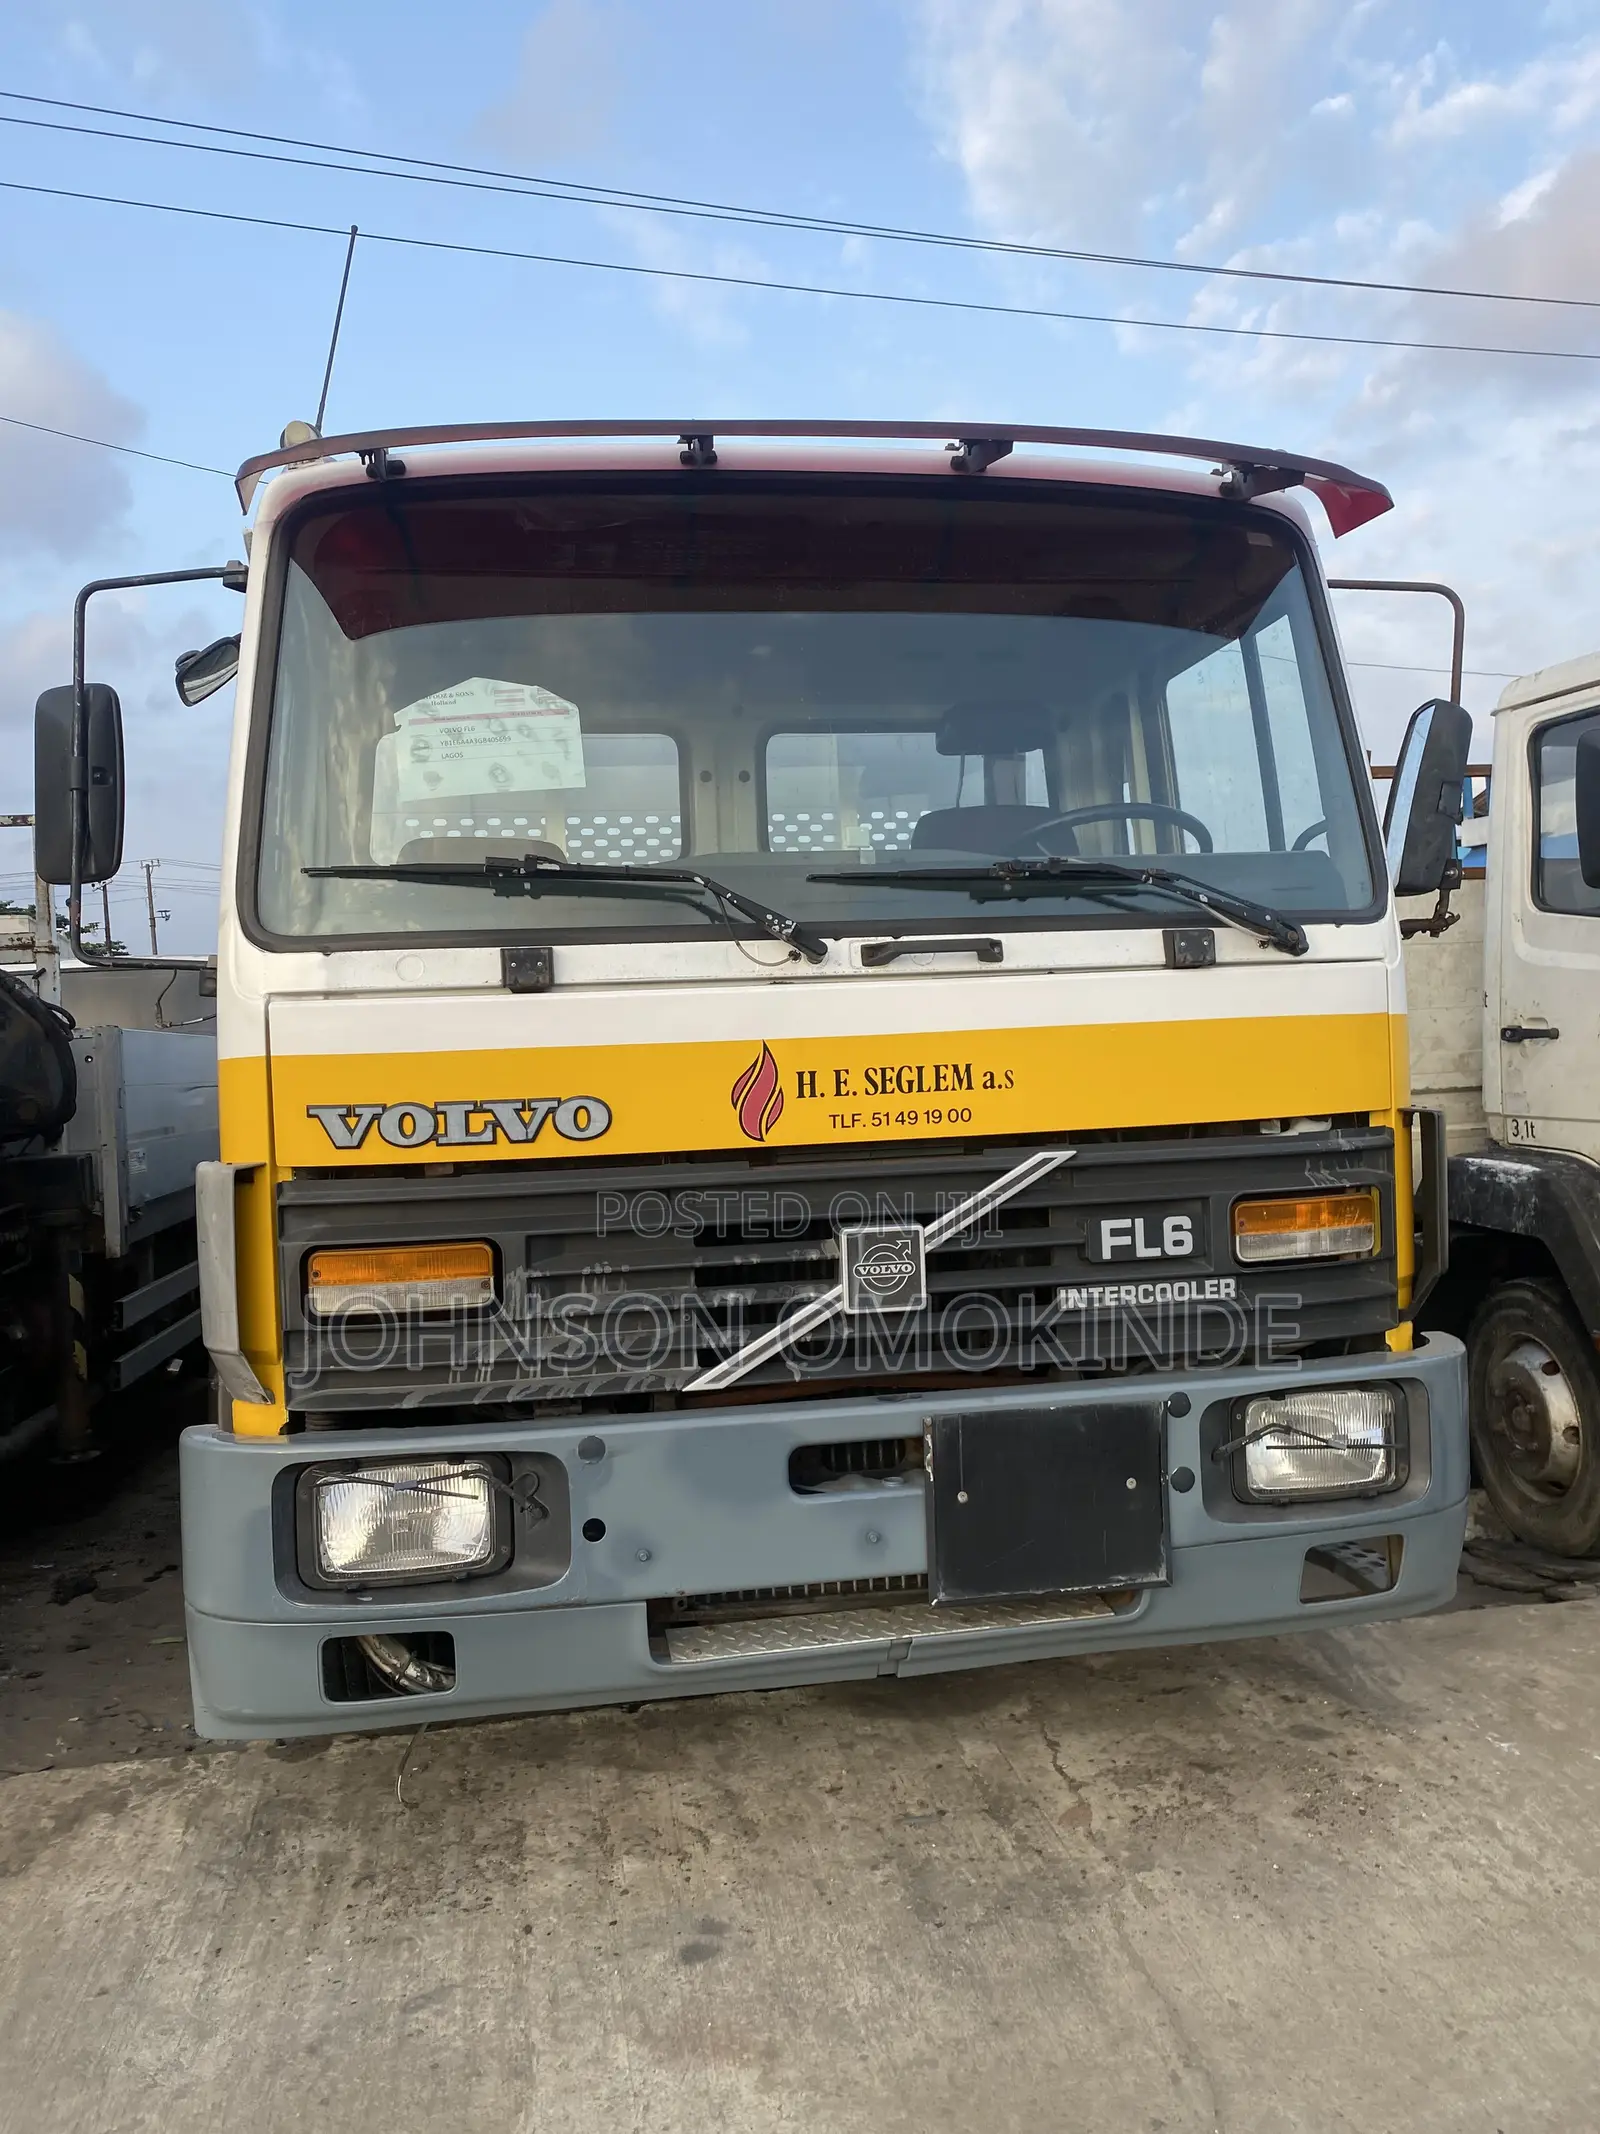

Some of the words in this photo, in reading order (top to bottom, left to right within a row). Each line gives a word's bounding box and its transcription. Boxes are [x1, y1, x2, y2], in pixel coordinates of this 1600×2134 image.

[441, 751, 464, 760] LAGOS
[796, 1071, 825, 1099] H.
[833, 1068, 858, 1097] E.
[864, 1063, 975, 1096] SEGLEM
[982, 1069, 1014, 1090] a.s
[306, 1095, 613, 1150] VOLVO
[828, 1113, 867, 1129] TLF.
[871, 1112, 890, 1127] 51
[894, 1111, 919, 1126] 49
[923, 1109, 943, 1124] 19
[947, 1107, 973, 1123] 00
[1100, 1216, 1194, 1260] FL6
[856, 1263, 913, 1275] VOLVO
[1059, 1278, 1236, 1309] INTERCOOLER
